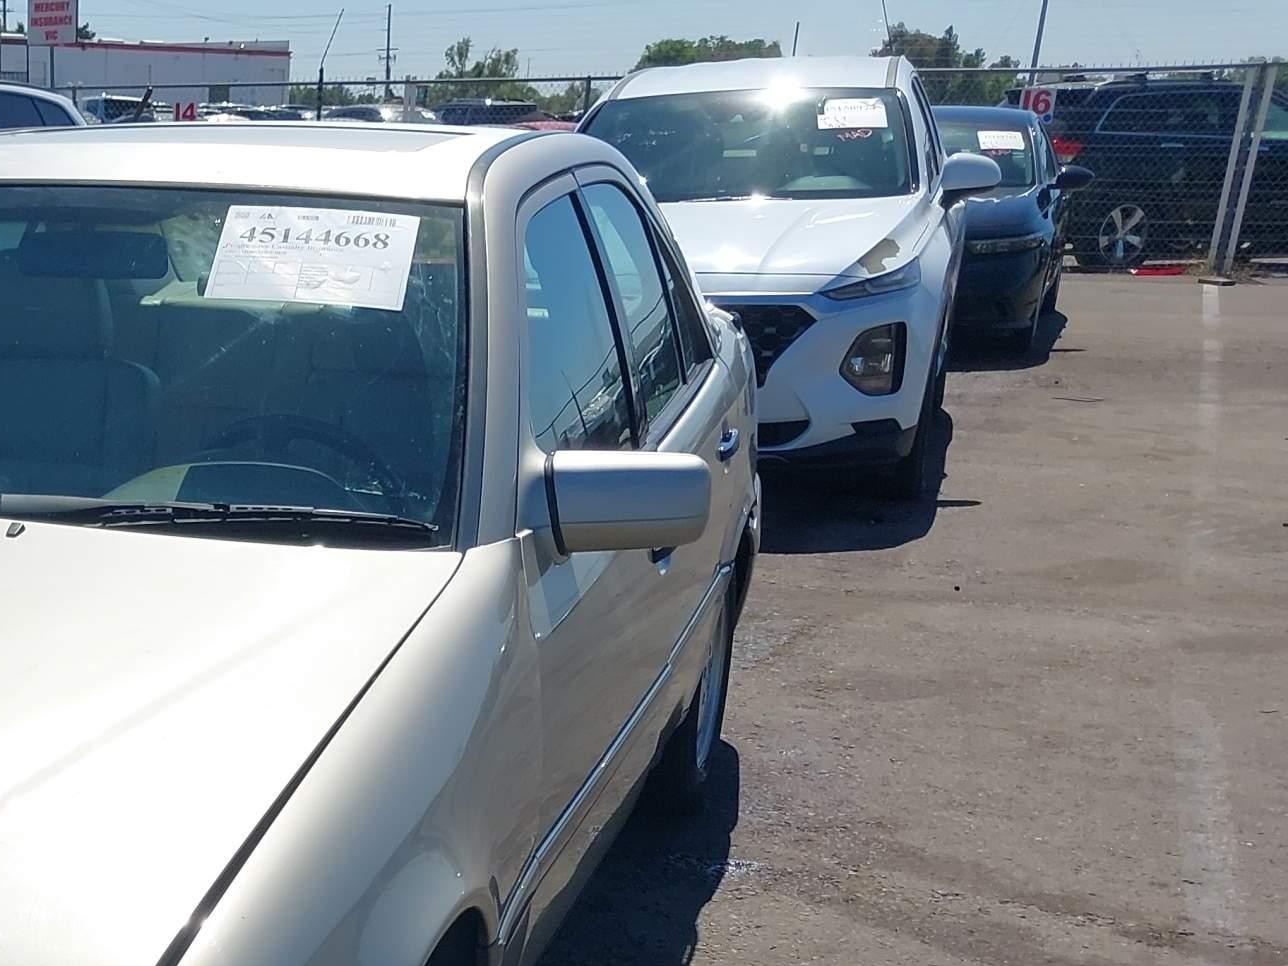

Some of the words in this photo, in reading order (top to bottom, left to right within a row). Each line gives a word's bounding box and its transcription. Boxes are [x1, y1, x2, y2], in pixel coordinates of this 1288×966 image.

[31, 16, 73, 27] INSURANCE
[175, 102, 197, 122] 14
[1022, 89, 1052, 115] 16
[239, 226, 391, 250] 45144668
